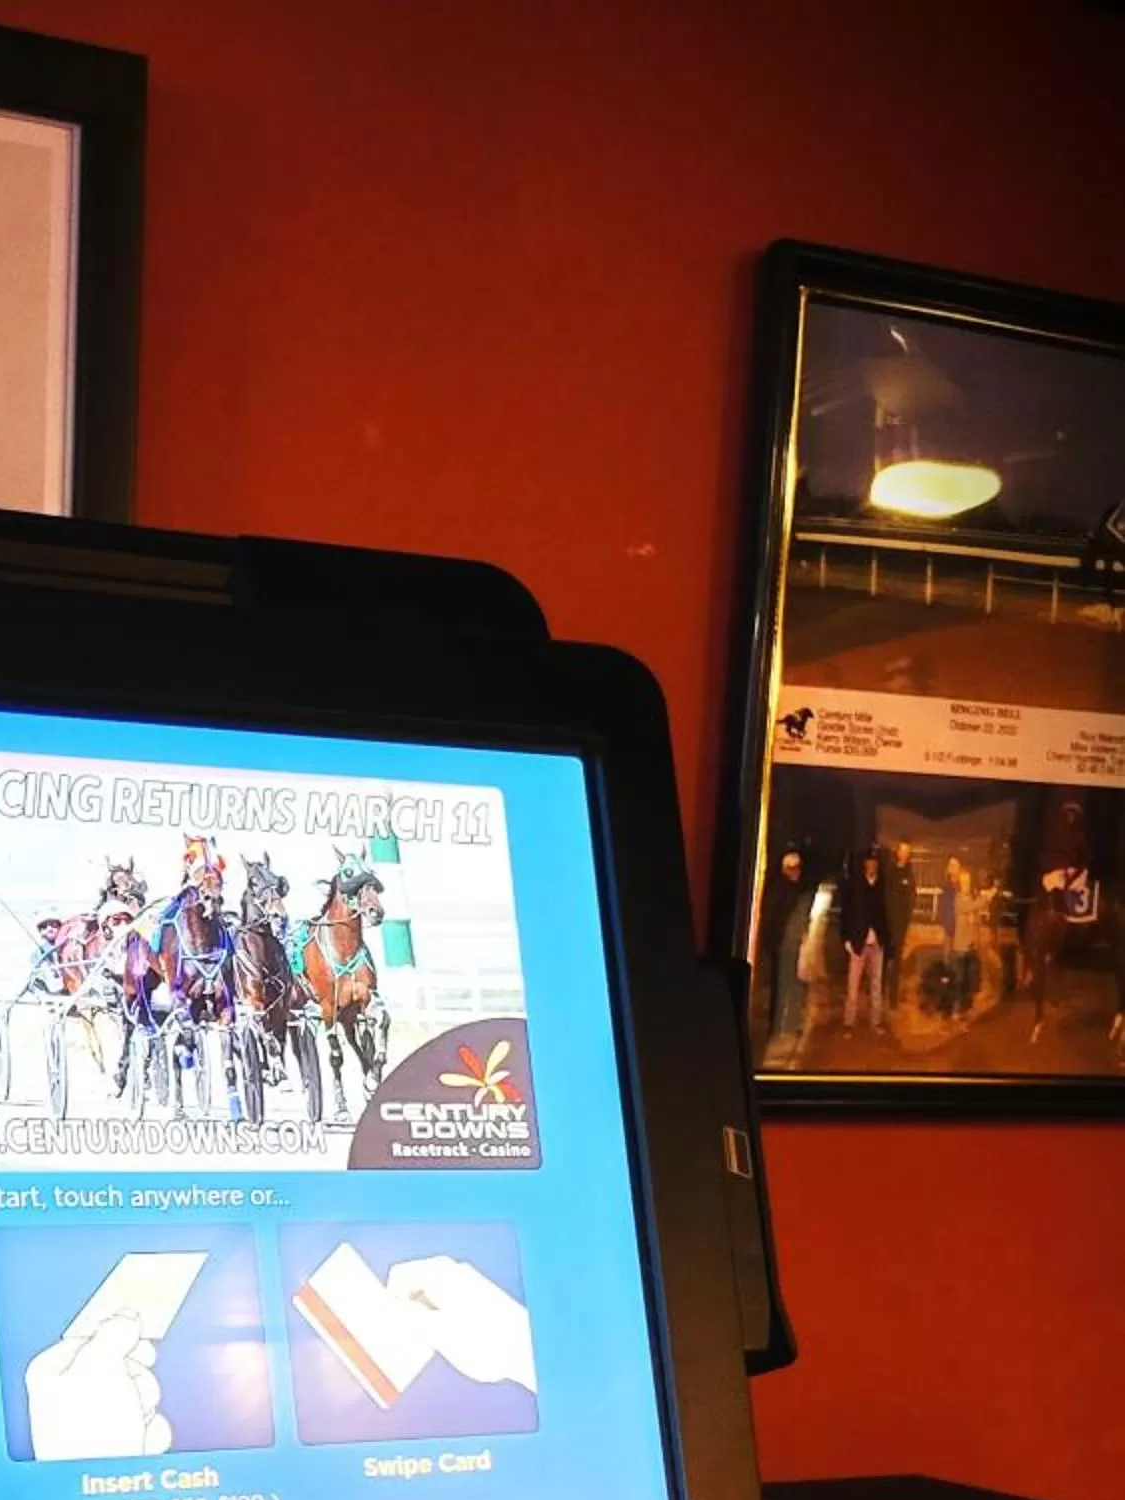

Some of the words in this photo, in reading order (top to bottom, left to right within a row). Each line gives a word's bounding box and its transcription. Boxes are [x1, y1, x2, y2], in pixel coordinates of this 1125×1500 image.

[111, 777, 296, 835] RETURNS
[304, 791, 443, 843] MARCH
[451, 800, 493, 846] 11
[380, 1102, 527, 1121] CENTURY
[410, 1121, 530, 1139] DOWNS
[479, 1143, 531, 1157] Casino
[54, 1185, 124, 1209] touch
[130, 1184, 244, 1212] anywhere
[363, 1454, 432, 1480] Swipe
[437, 1449, 493, 1473] Card
[82, 1470, 155, 1496] Insert
[160, 1465, 220, 1490] Cash
